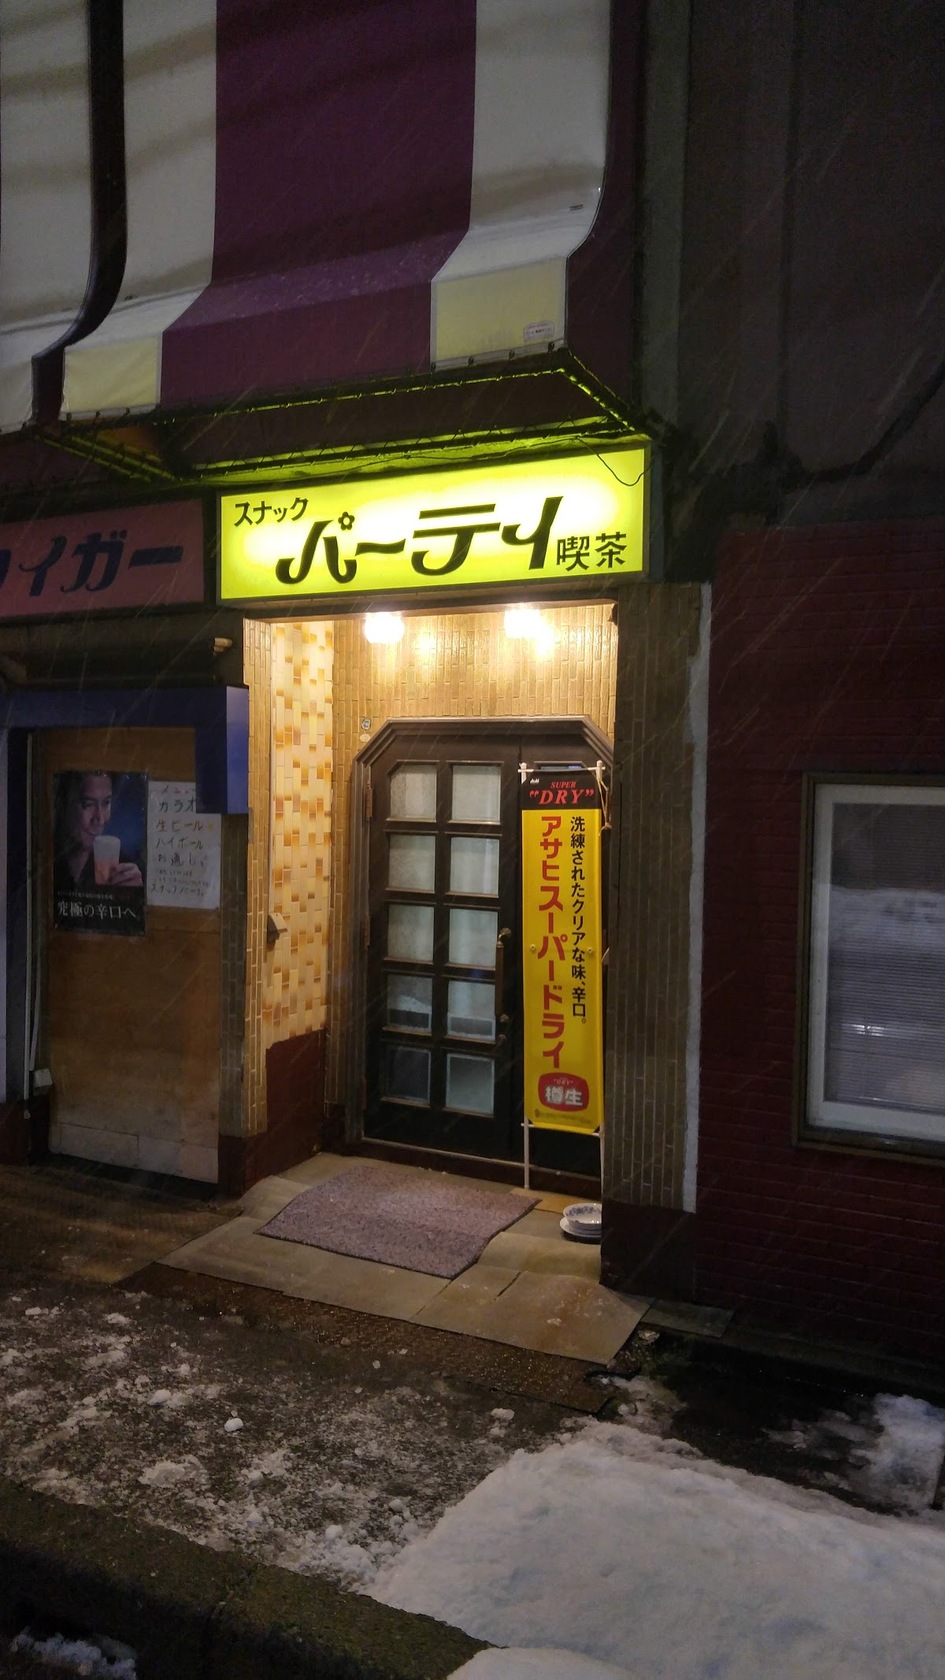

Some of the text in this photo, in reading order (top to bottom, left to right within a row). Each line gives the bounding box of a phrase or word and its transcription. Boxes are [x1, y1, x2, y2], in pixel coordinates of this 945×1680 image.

[234, 496, 308, 527] スナック
[556, 531, 628, 571] 喫茶
[551, 781, 577, 789] SUPER
[57, 899, 137, 920] 究極の辛口へ
[570, 816, 587, 1025] 洗練されたクリアな味、辛口。
[537, 816, 568, 1069] アサヒスーパードライ
